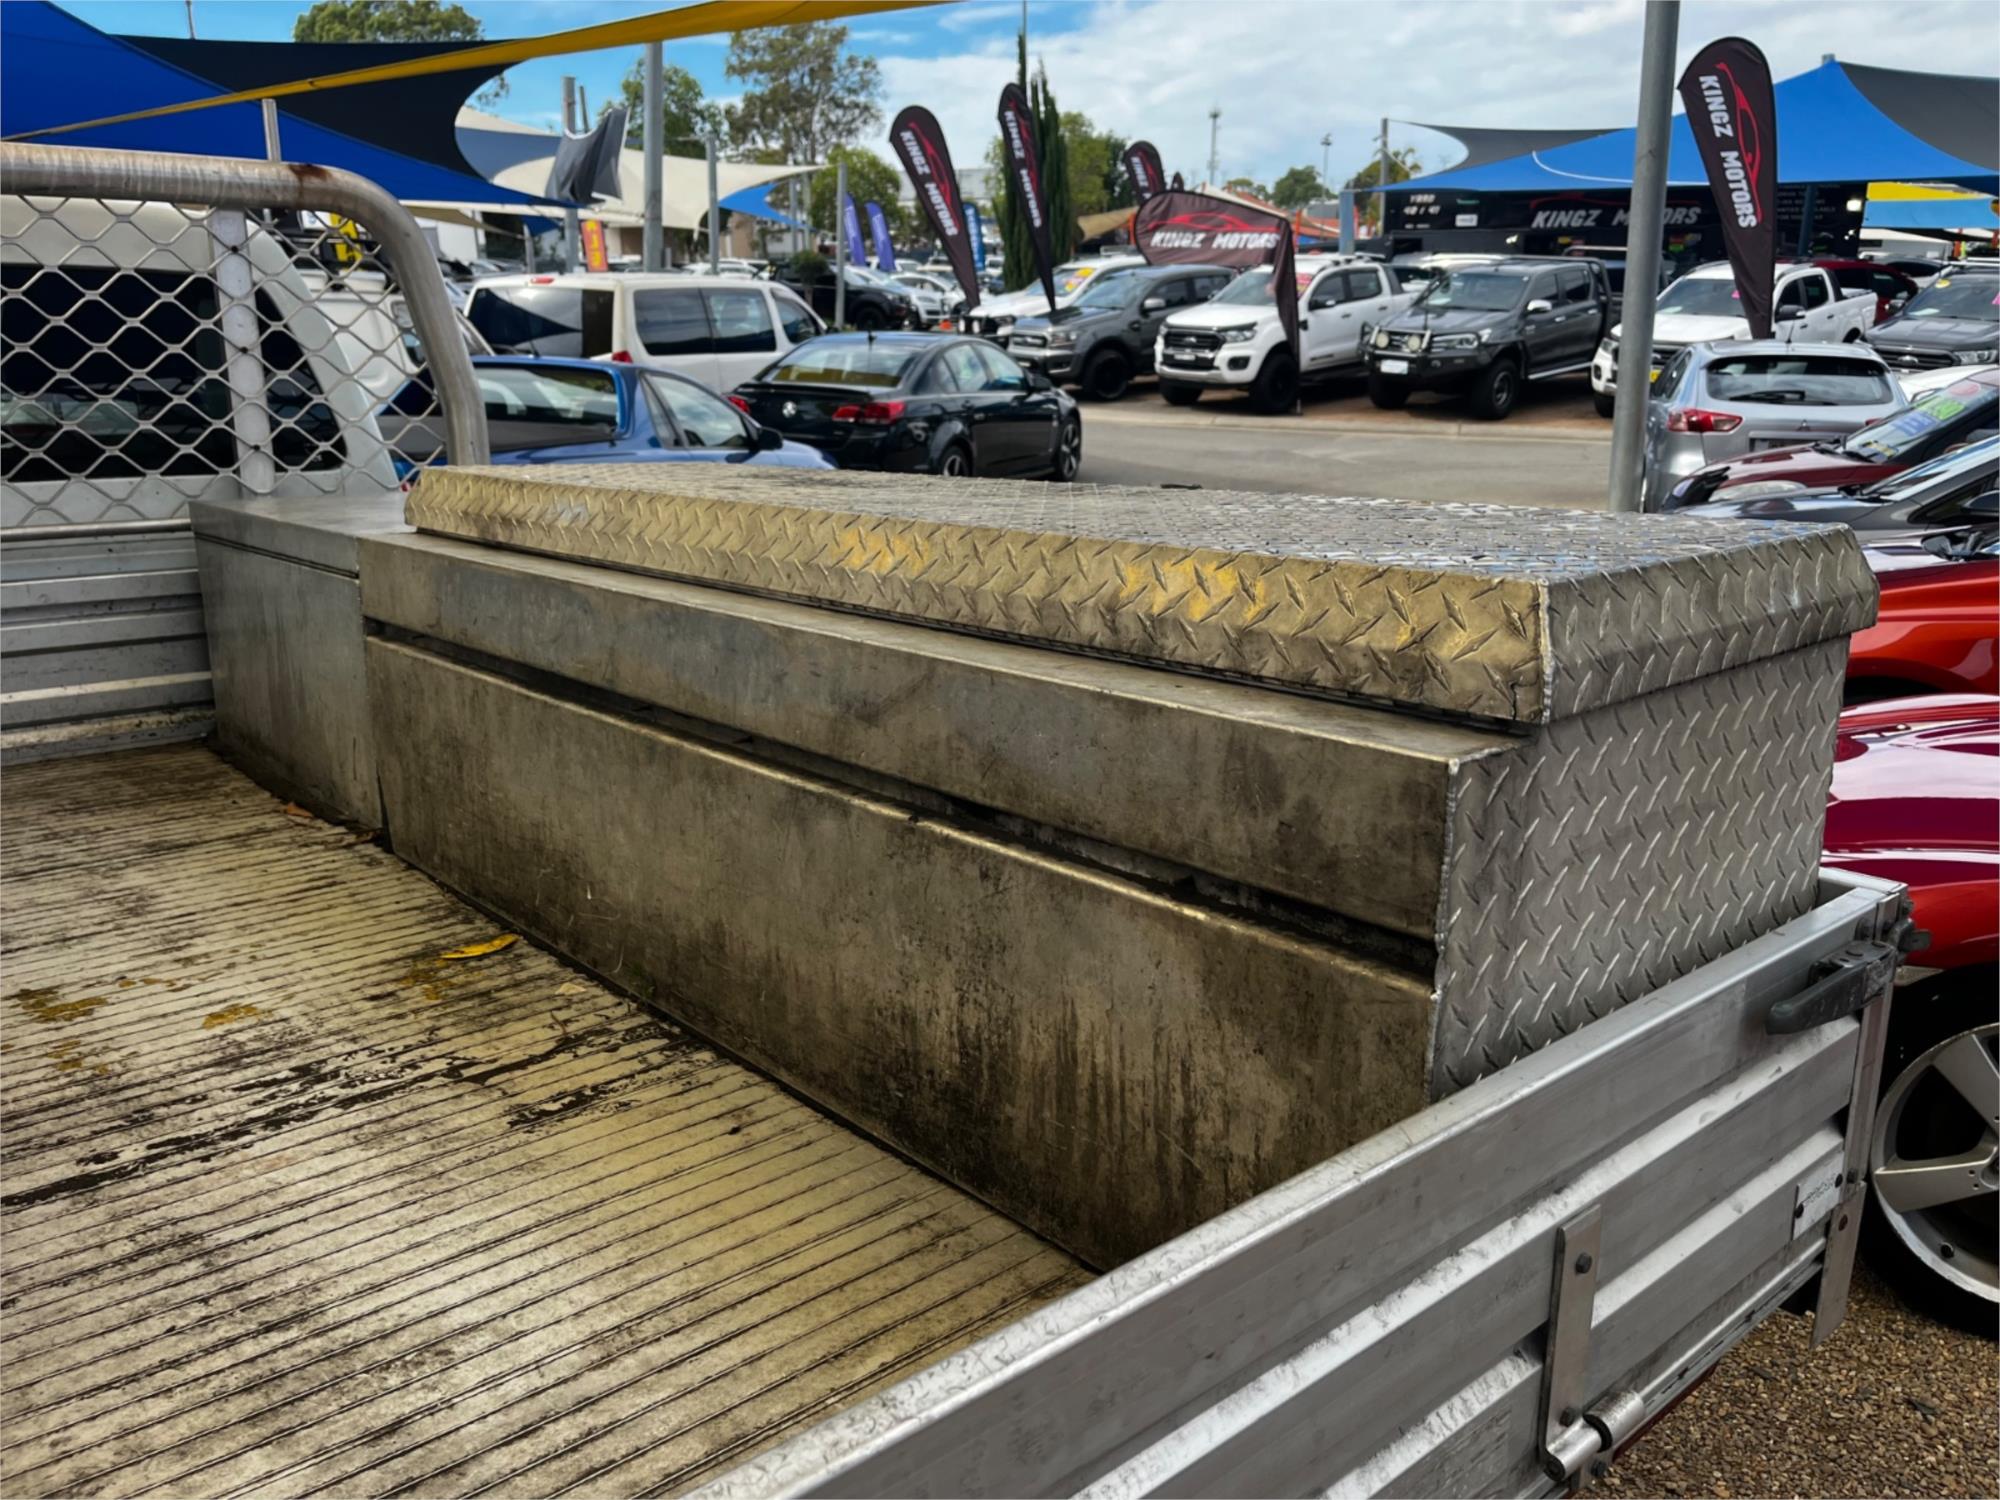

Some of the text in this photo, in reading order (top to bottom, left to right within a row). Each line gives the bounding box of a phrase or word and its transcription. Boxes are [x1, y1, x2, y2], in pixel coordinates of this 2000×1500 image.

[900, 131, 958, 236] KINGZ MOTORS
[1004, 110, 1042, 228] KINGZ MOTORS
[1699, 75, 1757, 228] KINGZ MOTORS
[1150, 231, 1281, 249] KINGZ MOTORS
[1531, 207, 1701, 228] KINGZ MORS
